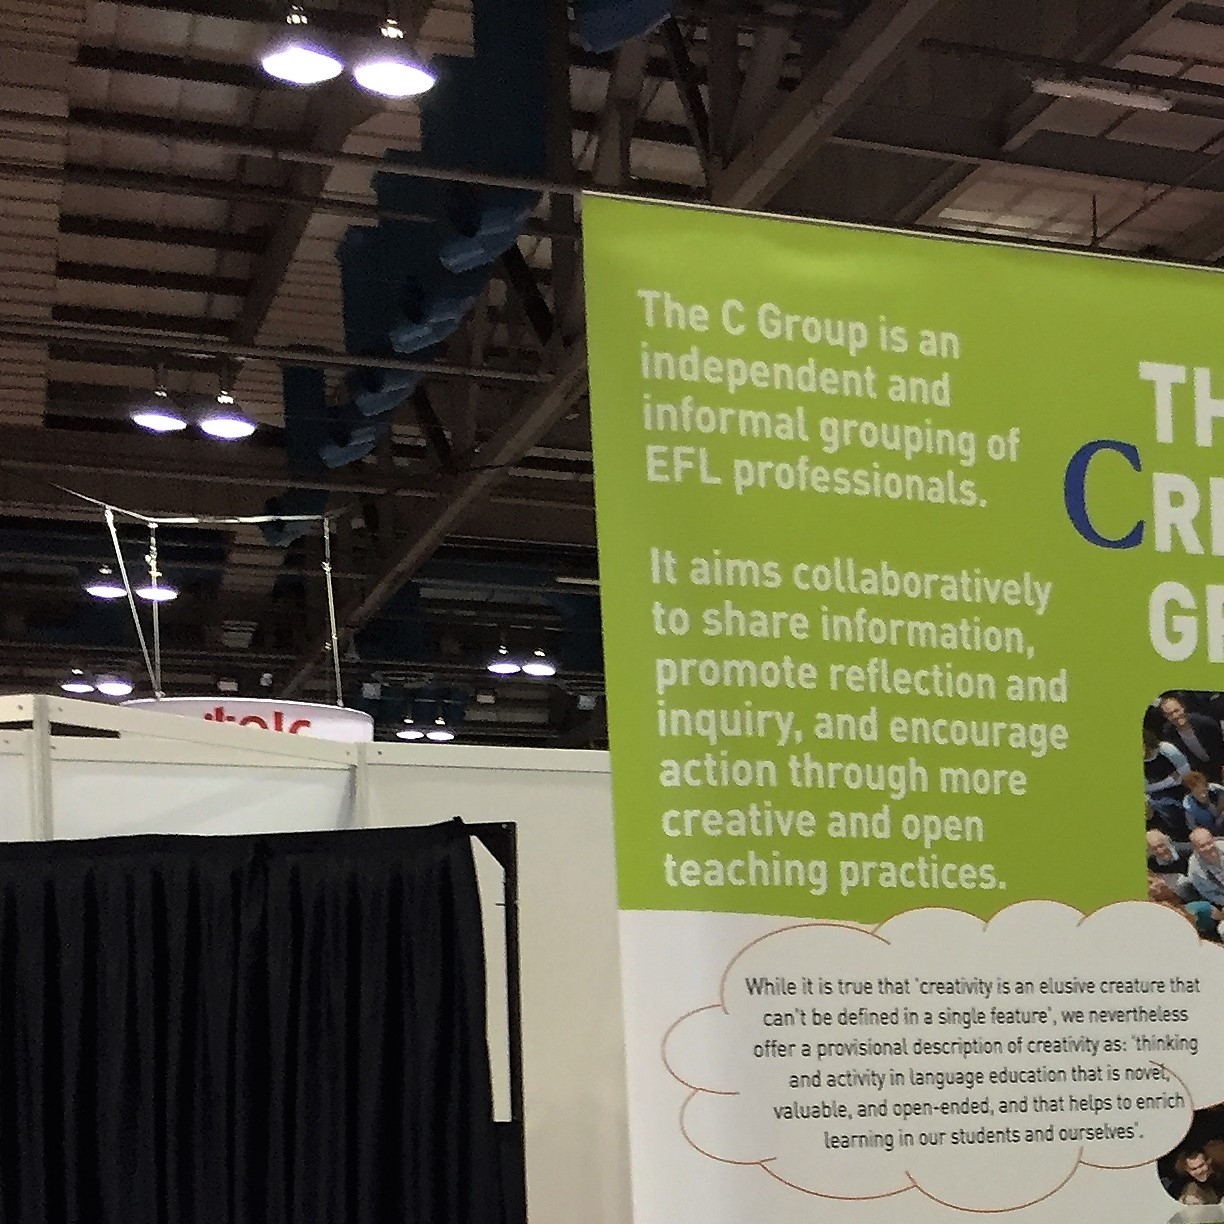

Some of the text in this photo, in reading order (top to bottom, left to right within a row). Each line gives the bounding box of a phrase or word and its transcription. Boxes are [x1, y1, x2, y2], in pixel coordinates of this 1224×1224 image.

[636, 287, 962, 360] The C Group is an
[640, 341, 952, 408] independent and
[642, 394, 1021, 466] informal grouping of
[645, 443, 988, 508] EFL professionals.
[650, 547, 1054, 614] It aims collaboratively
[651, 600, 1036, 660] to share information,
[654, 655, 1070, 704] promote reflection and
[657, 700, 1070, 759] inquiry, and encourage
[658, 752, 1029, 801] action through more
[661, 802, 985, 849] creative and open
[663, 851, 1007, 897] teaching practices.
[744, 976, 798, 996] While
[801, 976, 814, 996] it
[818, 976, 835, 996] is
[836, 978, 874, 996] true
[876, 976, 911, 995] that
[996, 976, 1012, 996] is
[1014, 980, 1035, 995] an
[1038, 976, 1096, 995] elusive
[1099, 977, 1167, 994] creature
[1168, 975, 1201, 994] that
[752, 1039, 797, 1059] offer
[800, 1043, 812, 1058] a
[816, 1037, 910, 1062] provisional
[912, 1036, 1004, 1060] description
[1006, 1035, 1024, 1055] of
[1025, 1035, 1101, 1057] creativity
[1102, 1038, 1128, 1053] as:
[823, 1129, 895, 1153] learning
[898, 1128, 915, 1148] in
[917, 1131, 948, 1146] our
[950, 1126, 1022, 1146] students
[1023, 1123, 1055, 1143] and
